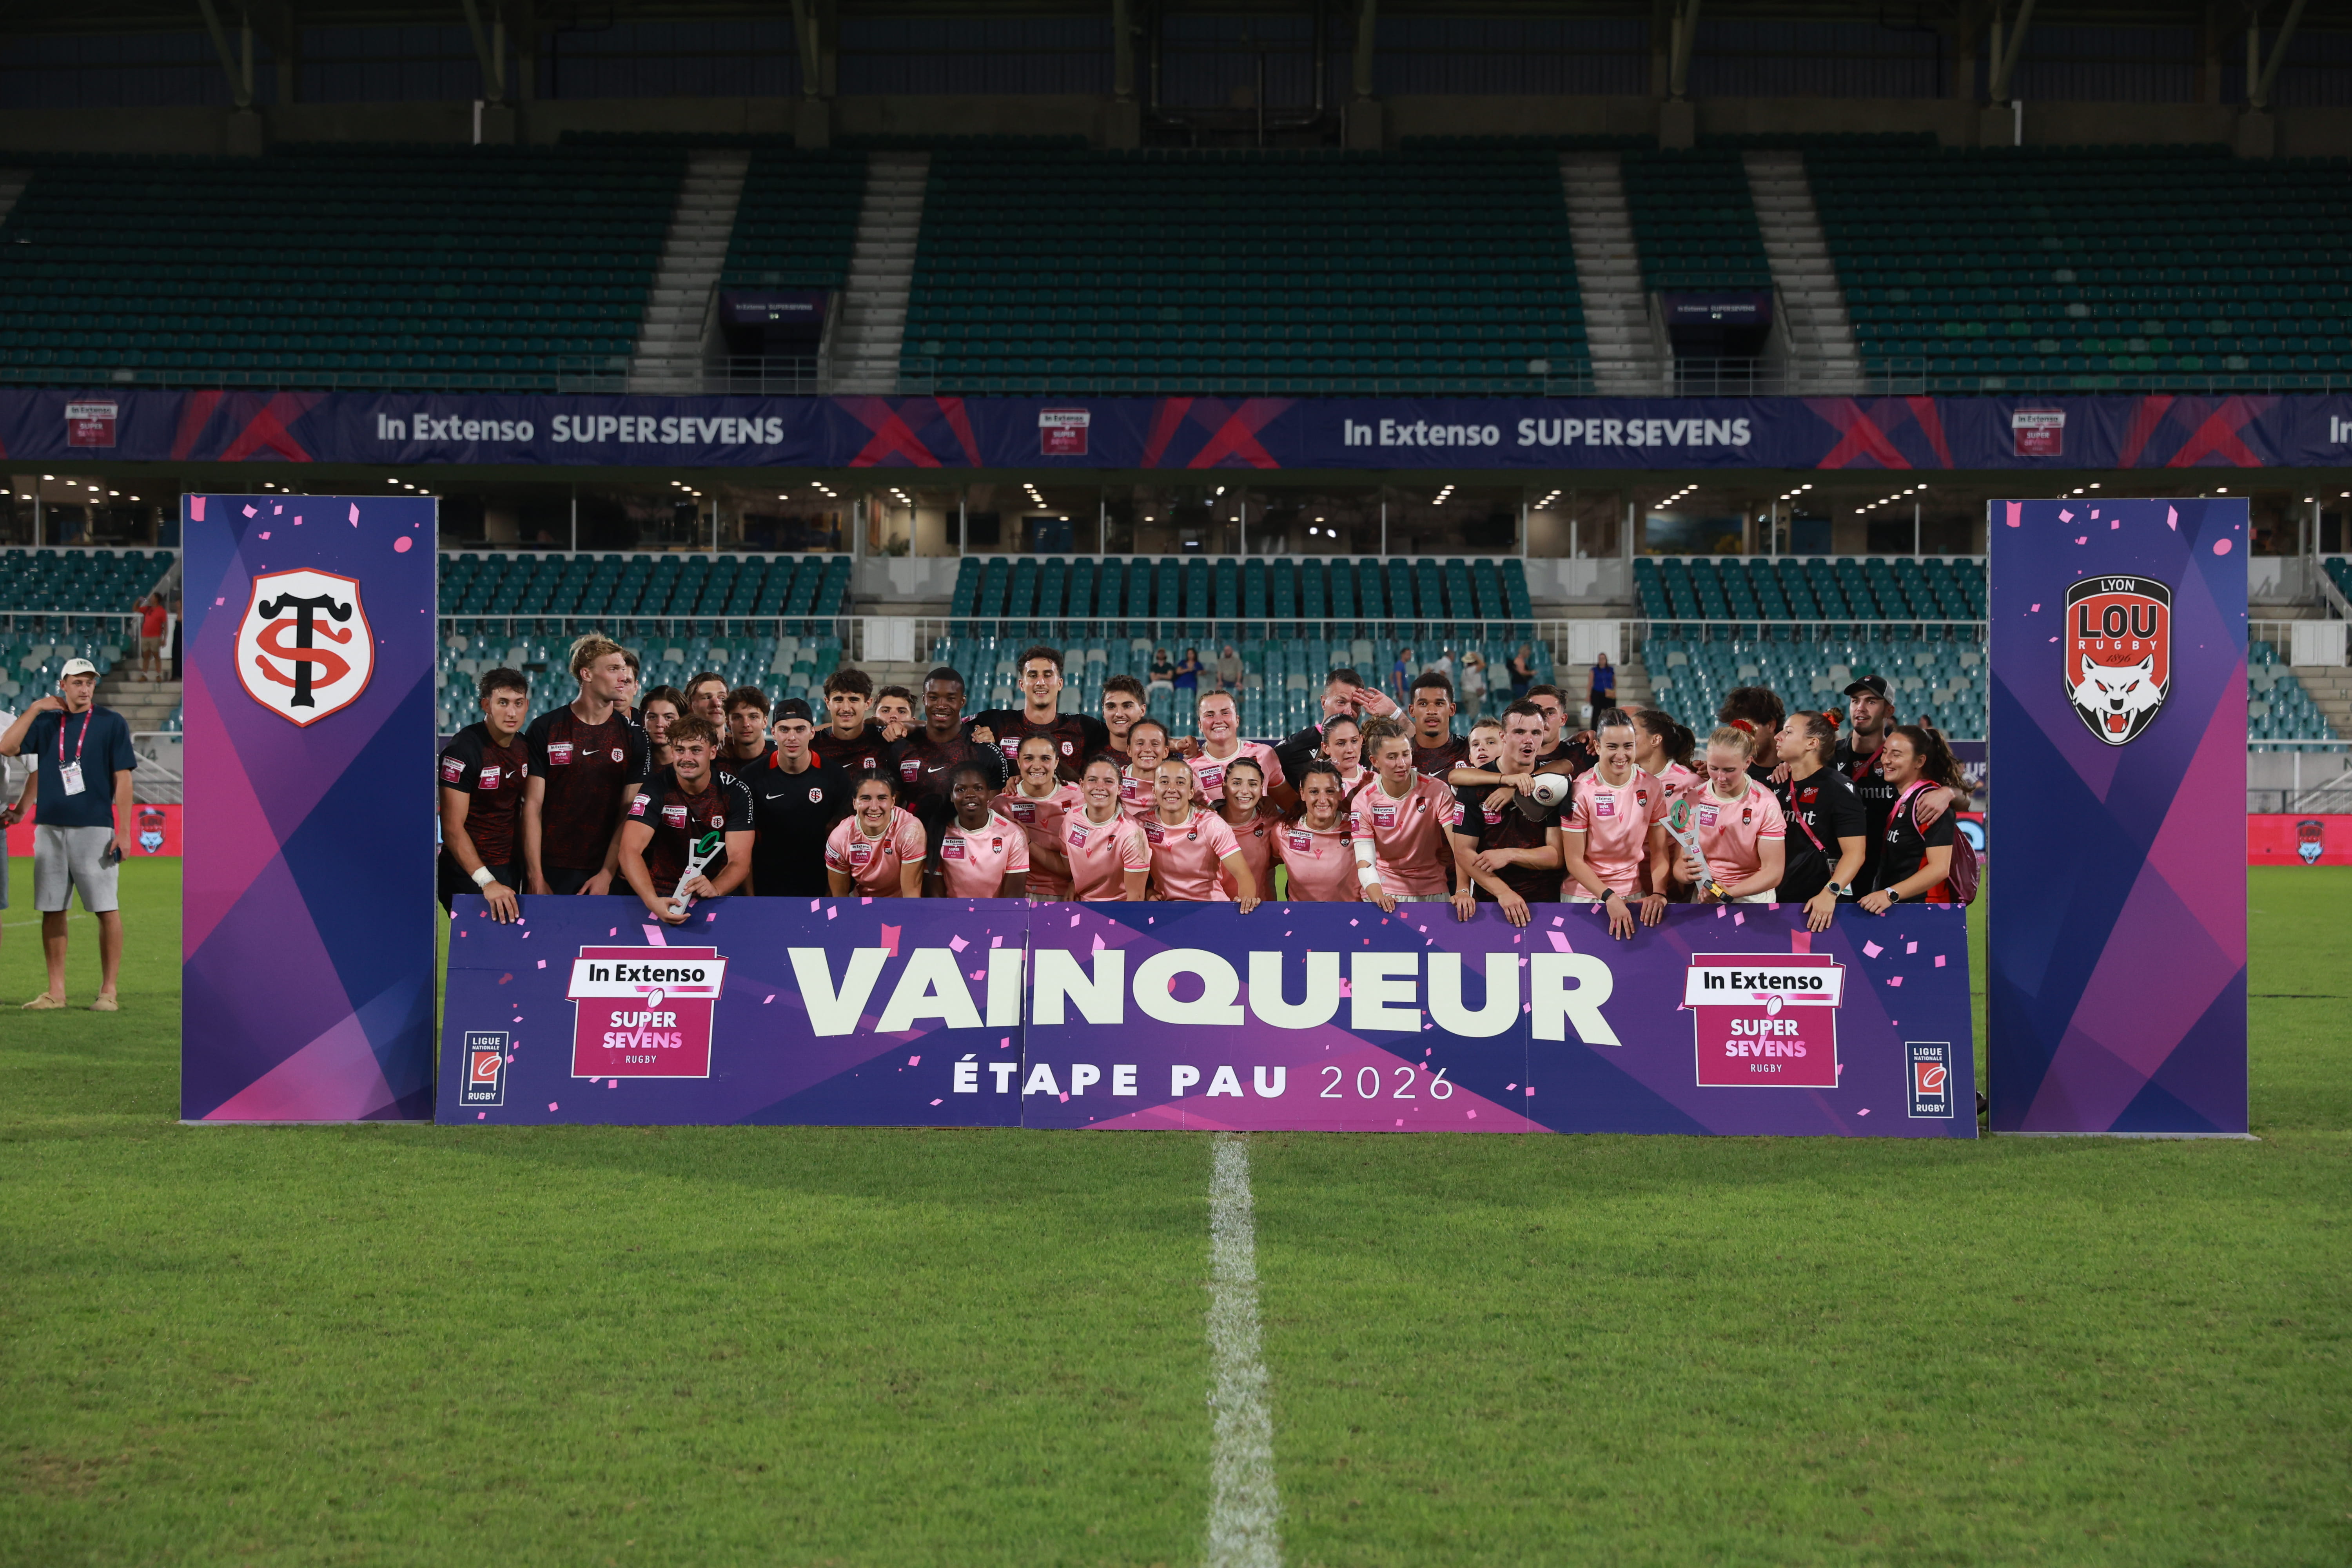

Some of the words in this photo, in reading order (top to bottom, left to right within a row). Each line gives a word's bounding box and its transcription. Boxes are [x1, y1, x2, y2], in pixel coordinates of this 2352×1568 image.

[377, 414, 406, 440] In
[413, 414, 534, 441] Extenso
[552, 415, 784, 445] SUPERSEVENS
[1345, 419, 1371, 446] In
[1379, 419, 1500, 446] Extenso
[1517, 418, 1751, 446] SUPERSEVENS
[2101, 579, 2135, 592] LYON
[2078, 604, 2158, 639] LOU
[2078, 641, 2157, 650] RUGBY
[2105, 653, 2133, 662] 1896
[1804, 788, 1819, 797] events
[589, 964, 609, 981] In
[616, 964, 705, 982] Extenso
[1704, 972, 1724, 989] In
[1731, 972, 1822, 990] Extenso
[787, 947, 1622, 1046] VAINQUEUR
[610, 1011, 677, 1027] SUPER
[1731, 1019, 1799, 1036] SUPER
[602, 1032, 682, 1048] SEVENS
[1725, 1040, 1807, 1057] SEVENS
[625, 1055, 657, 1063] RUGBY
[1750, 1064, 1782, 1073] RUGBY
[953, 1054, 1137, 1096] ÉTAPE
[1171, 1064, 1286, 1098] PAU
[1319, 1066, 1453, 1100] 2026
[1916, 1104, 1945, 1112] RUGBY
